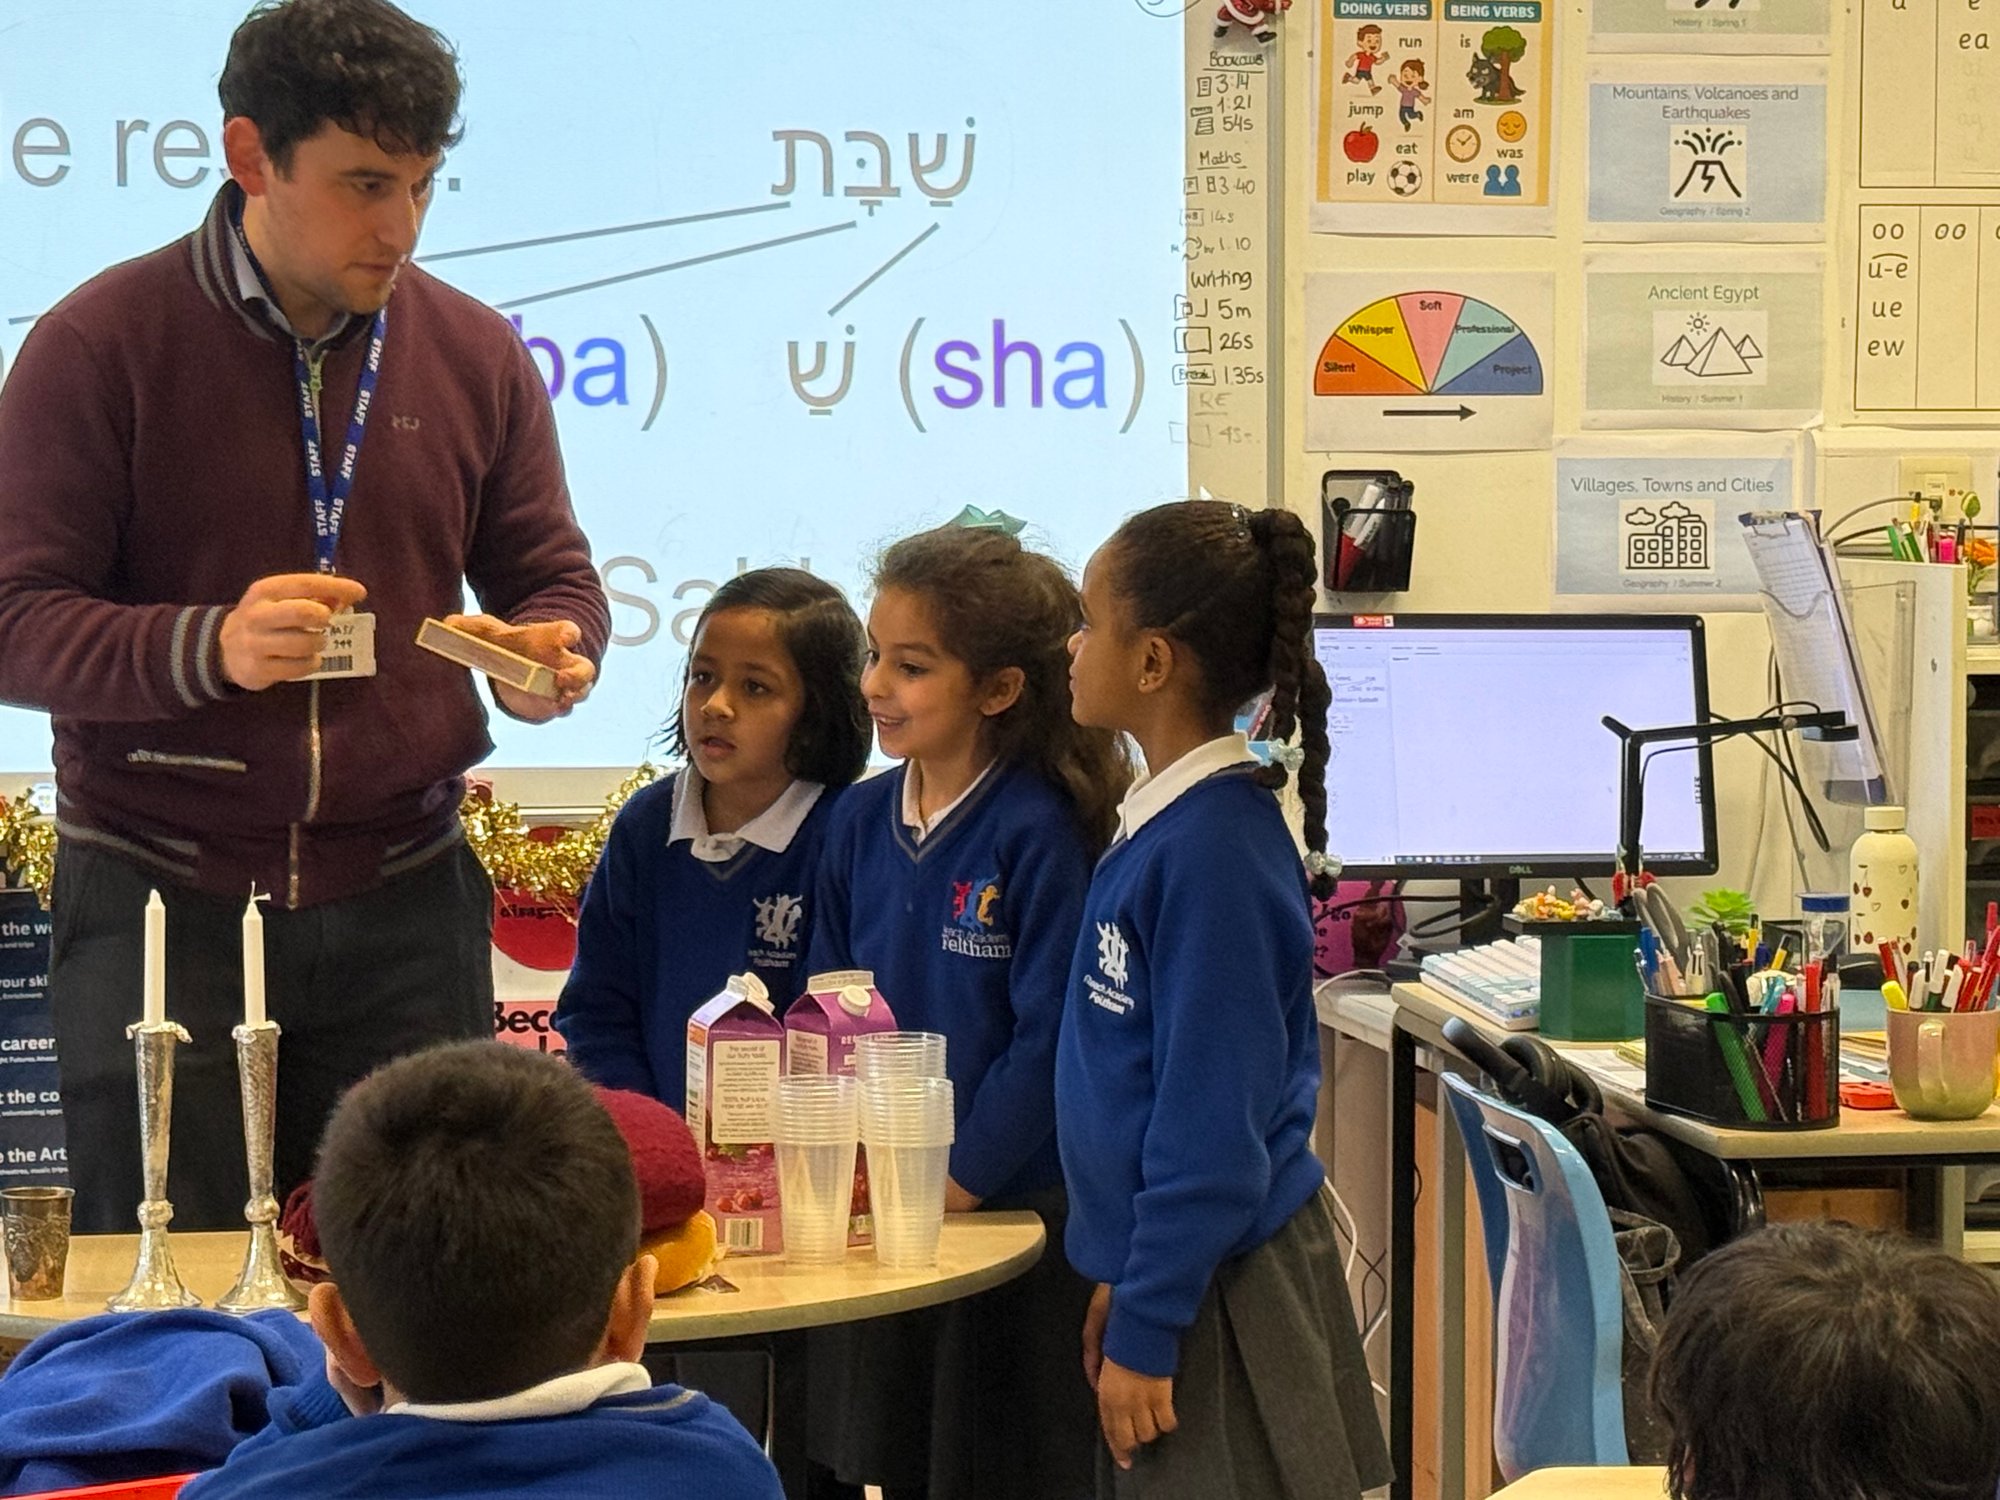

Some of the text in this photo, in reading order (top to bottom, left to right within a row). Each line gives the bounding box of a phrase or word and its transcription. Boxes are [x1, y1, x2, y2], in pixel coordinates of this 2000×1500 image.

[1340, 2, 1427, 16] DOING VERBS
[1451, 5, 1535, 18] BEING VERBS
[1399, 37, 1422, 48] run
[1460, 33, 1471, 48] is
[1959, 33, 1990, 50] ea
[1613, 86, 1799, 101] Mountains, Volcanoes and
[1347, 101, 1384, 118] jump
[1453, 108, 1474, 119] am
[1662, 104, 1751, 122] Earthquakes
[1396, 142, 1418, 154] eat
[1496, 148, 1523, 159] was
[1199, 150, 1242, 166] Maths
[1346, 168, 1375, 185] play
[1446, 173, 1480, 184] were
[1660, 206, 1706, 218] Geography
[1716, 206, 1743, 218] Spring
[1873, 223, 1904, 240] oo
[1935, 223, 1967, 240] oo
[1868, 262, 1909, 279] u-e
[1648, 285, 1759, 304] Ancient Egypt
[1419, 300, 1443, 311] Soft
[1872, 301, 1902, 318] ue
[1348, 324, 1395, 337] Whisper
[1455, 324, 1515, 335] Professional
[368, 338, 382, 373] STAFF
[1867, 340, 1905, 357] ew
[1323, 361, 1356, 373] Silent
[1493, 364, 1533, 377] Project
[900, 316, 1145, 435] (sha)
[300, 380, 314, 418] STAFF
[354, 390, 371, 426] STAFF
[308, 440, 321, 477] STAFF
[340, 444, 357, 481] STAFF
[1571, 477, 1774, 495] Villages, Towns and Cities
[314, 498, 328, 536] STAFF
[329, 497, 344, 535] STAFF
[2, 922, 31, 936] the
[1, 1038, 55, 1051] career
[7, 1090, 36, 1105] the
[8, 1147, 67, 1163] the Art
